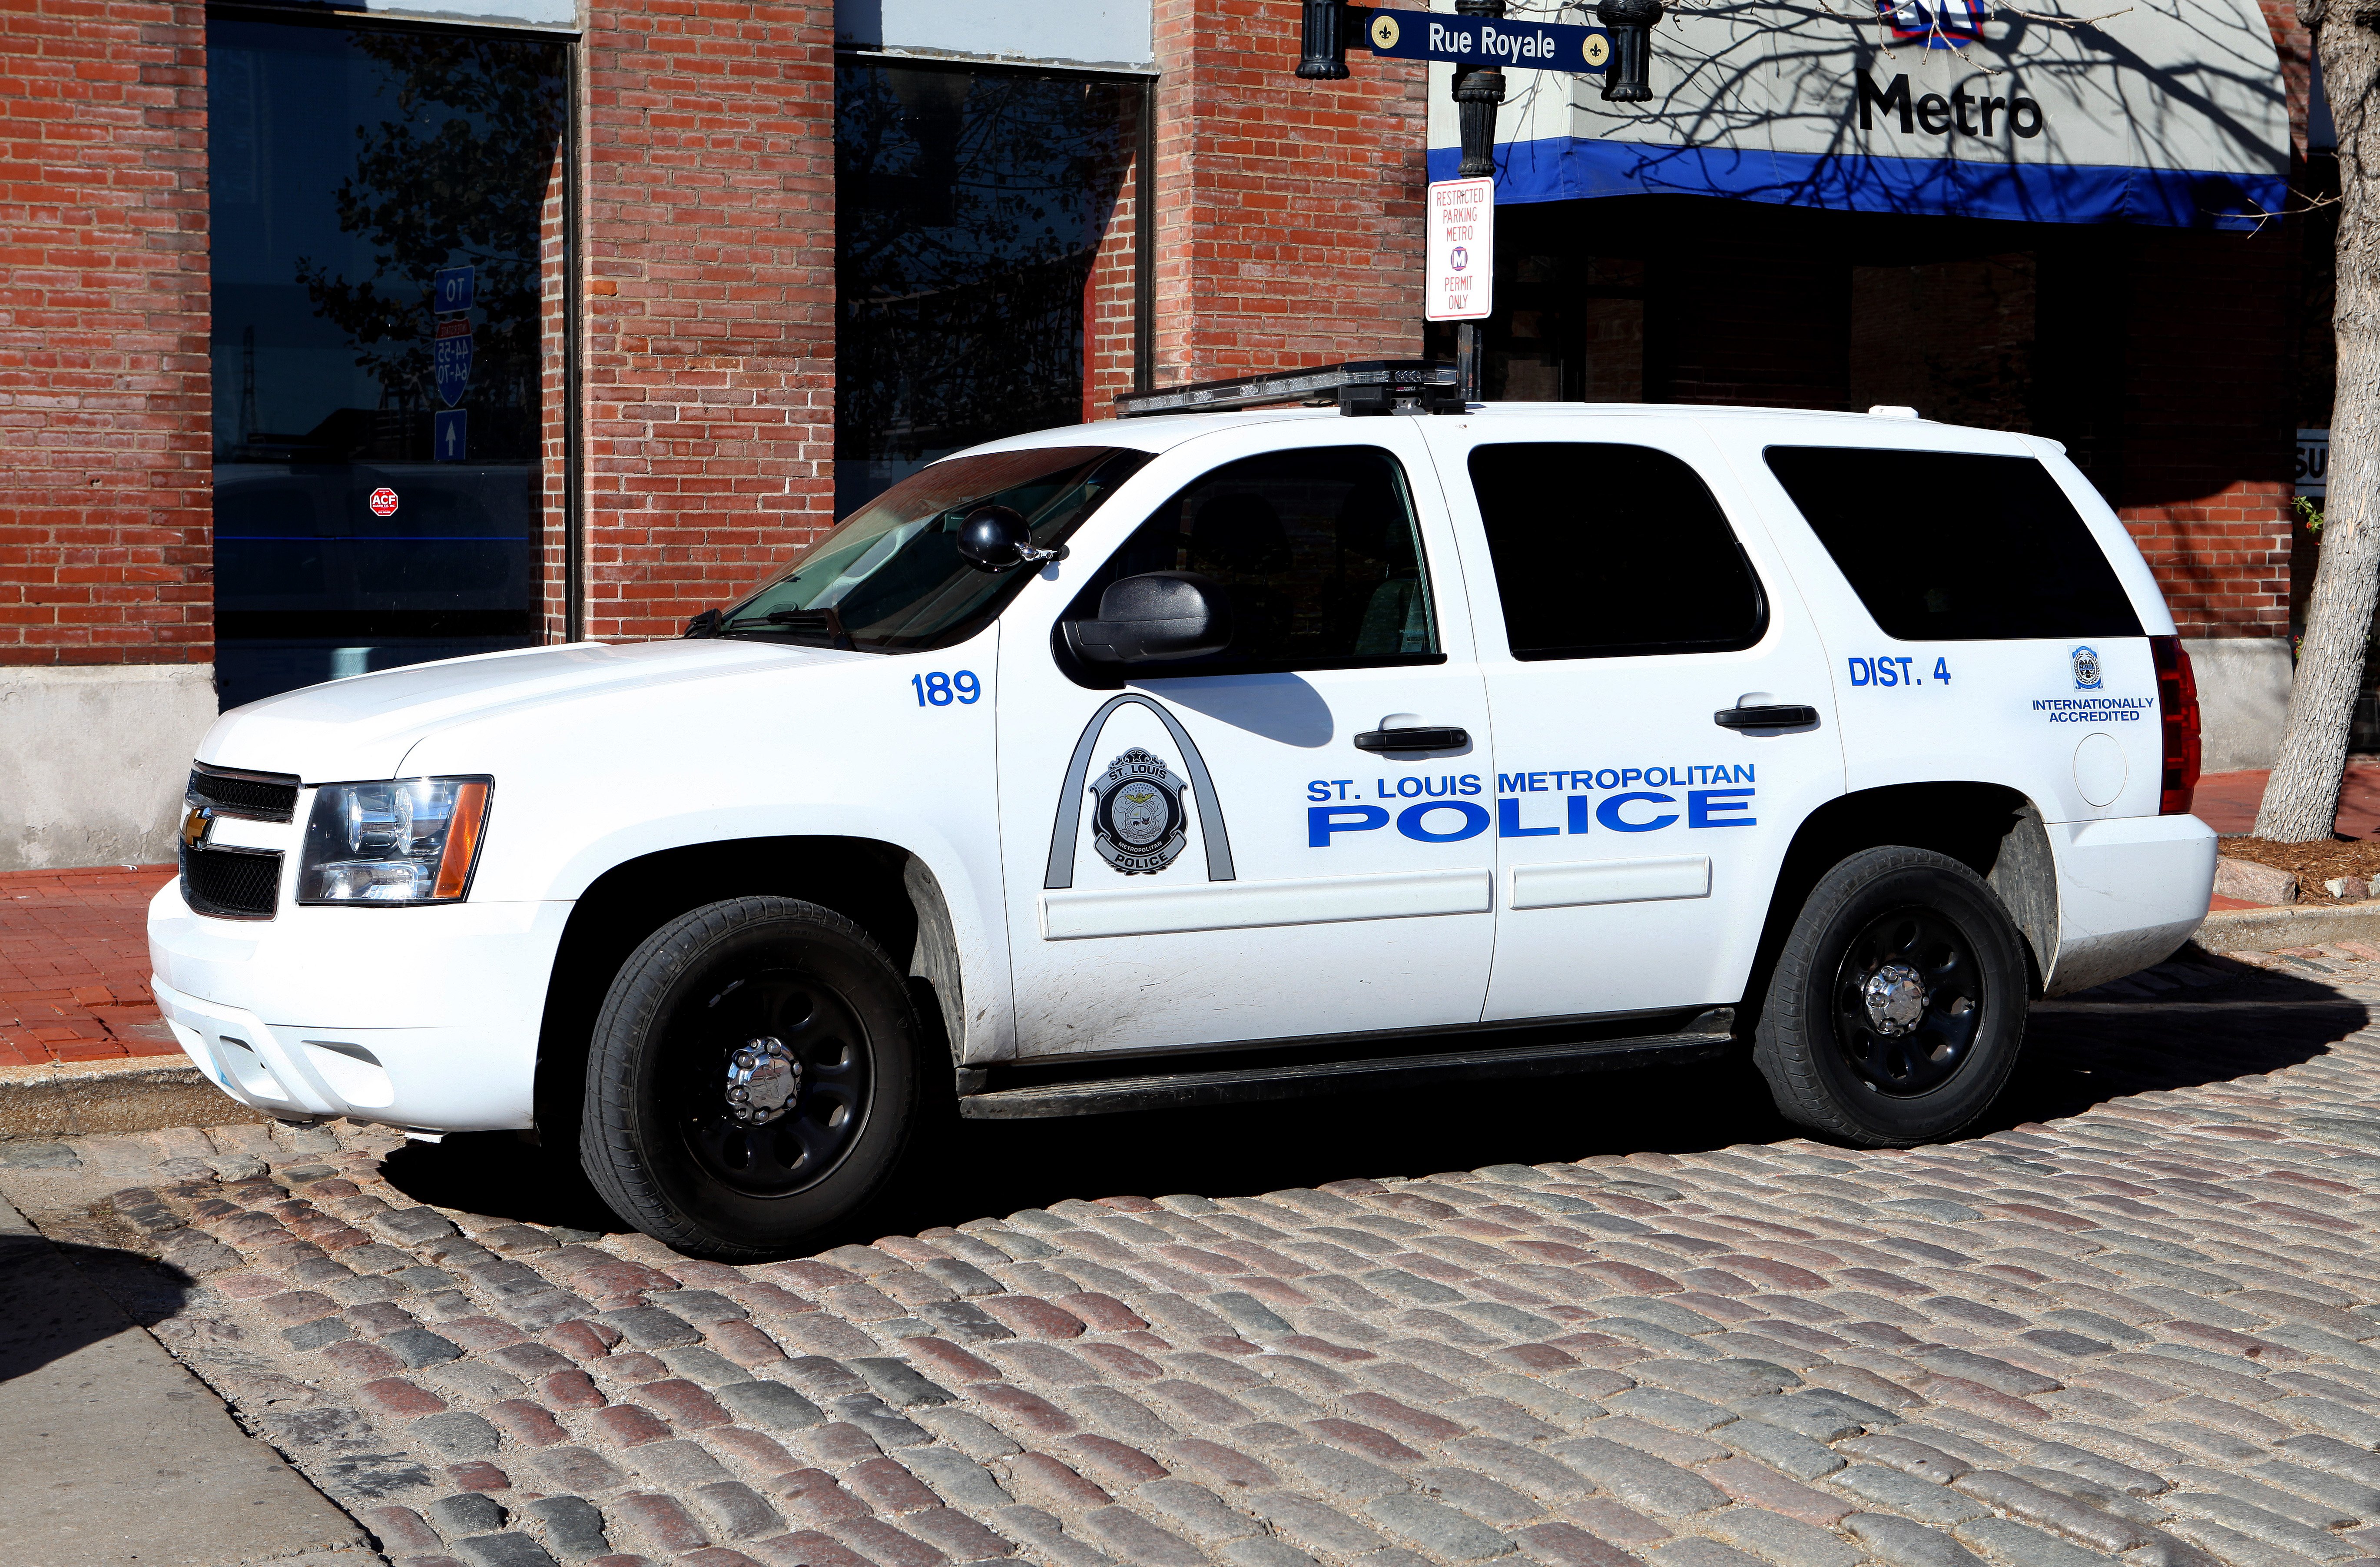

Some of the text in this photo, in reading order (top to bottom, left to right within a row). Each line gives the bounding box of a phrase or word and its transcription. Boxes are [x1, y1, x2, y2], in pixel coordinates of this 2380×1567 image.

[1429, 23, 1555, 63] Rue Royale
[1856, 67, 2042, 139] Metro
[1437, 188, 1484, 206] RESTRICTED
[1443, 206, 1477, 224] PARKING
[1446, 226, 1473, 242] METRO
[1445, 276, 1473, 292] PERMIT
[1449, 294, 1468, 309] ONLY
[372, 495, 396, 505] ACF
[1848, 656, 1951, 687] DIST. 4
[912, 670, 981, 707] 189
[2032, 697, 2154, 710] INTERNATIONALLY
[2049, 710, 2140, 723] ACCREDITED
[1109, 765, 1167, 781] ST. LOUIS
[1307, 764, 1755, 802] ST. LOUIS METROPOLITAN
[1308, 788, 1757, 848] POLICE
[1118, 841, 1162, 853] METROPOLITAN
[1114, 852, 1168, 868] POLICE
